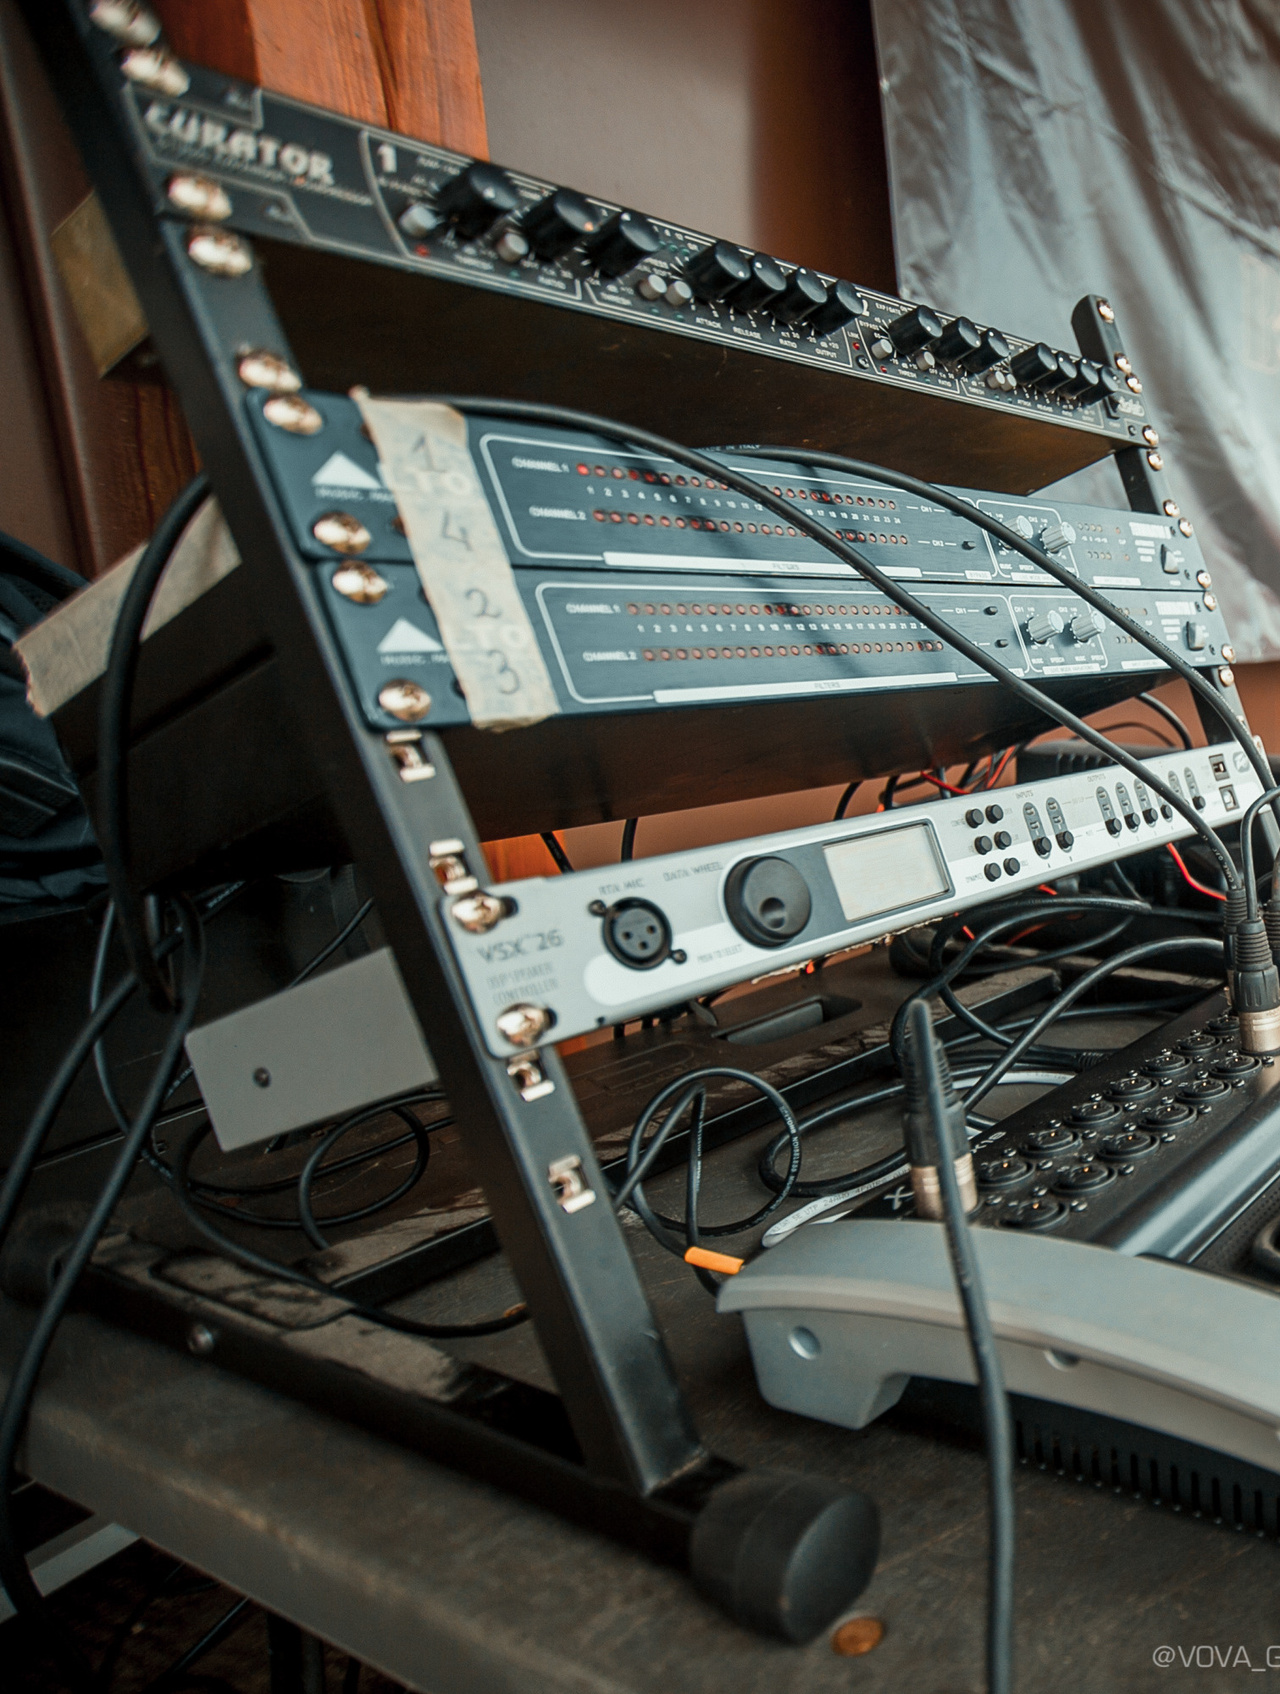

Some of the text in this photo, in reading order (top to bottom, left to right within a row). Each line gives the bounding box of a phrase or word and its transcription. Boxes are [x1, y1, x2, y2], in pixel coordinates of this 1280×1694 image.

[145, 101, 335, 186] CURATOR
[376, 144, 397, 173] 1
[695, 317, 722, 329] ATTACK
[859, 320, 879, 331] BYPASS
[732, 326, 763, 340] RELEASE
[778, 338, 797, 349] RATIO
[815, 347, 838, 359] OUTPUT
[511, 456, 562, 473] CHANNEL
[528, 506, 577, 520] CHANNEL
[920, 505, 933, 513] CH1
[440, 509, 473, 551] 4
[772, 562, 799, 571] FILTERS
[465, 588, 501, 618] 2
[566, 603, 613, 614] CHANNEL
[955, 607, 967, 615] CH1
[583, 651, 628, 662] CHANNEL
[488, 649, 520, 694] 3
[814, 681, 840, 690] FILTERS
[1087, 773, 1106, 783] OUTPUTS
[1015, 789, 1034, 799] INPUTS
[662, 861, 724, 882] DATA WHEEL
[476, 928, 563, 963] VSX 26
[492, 978, 560, 1003] CONTROLLER
